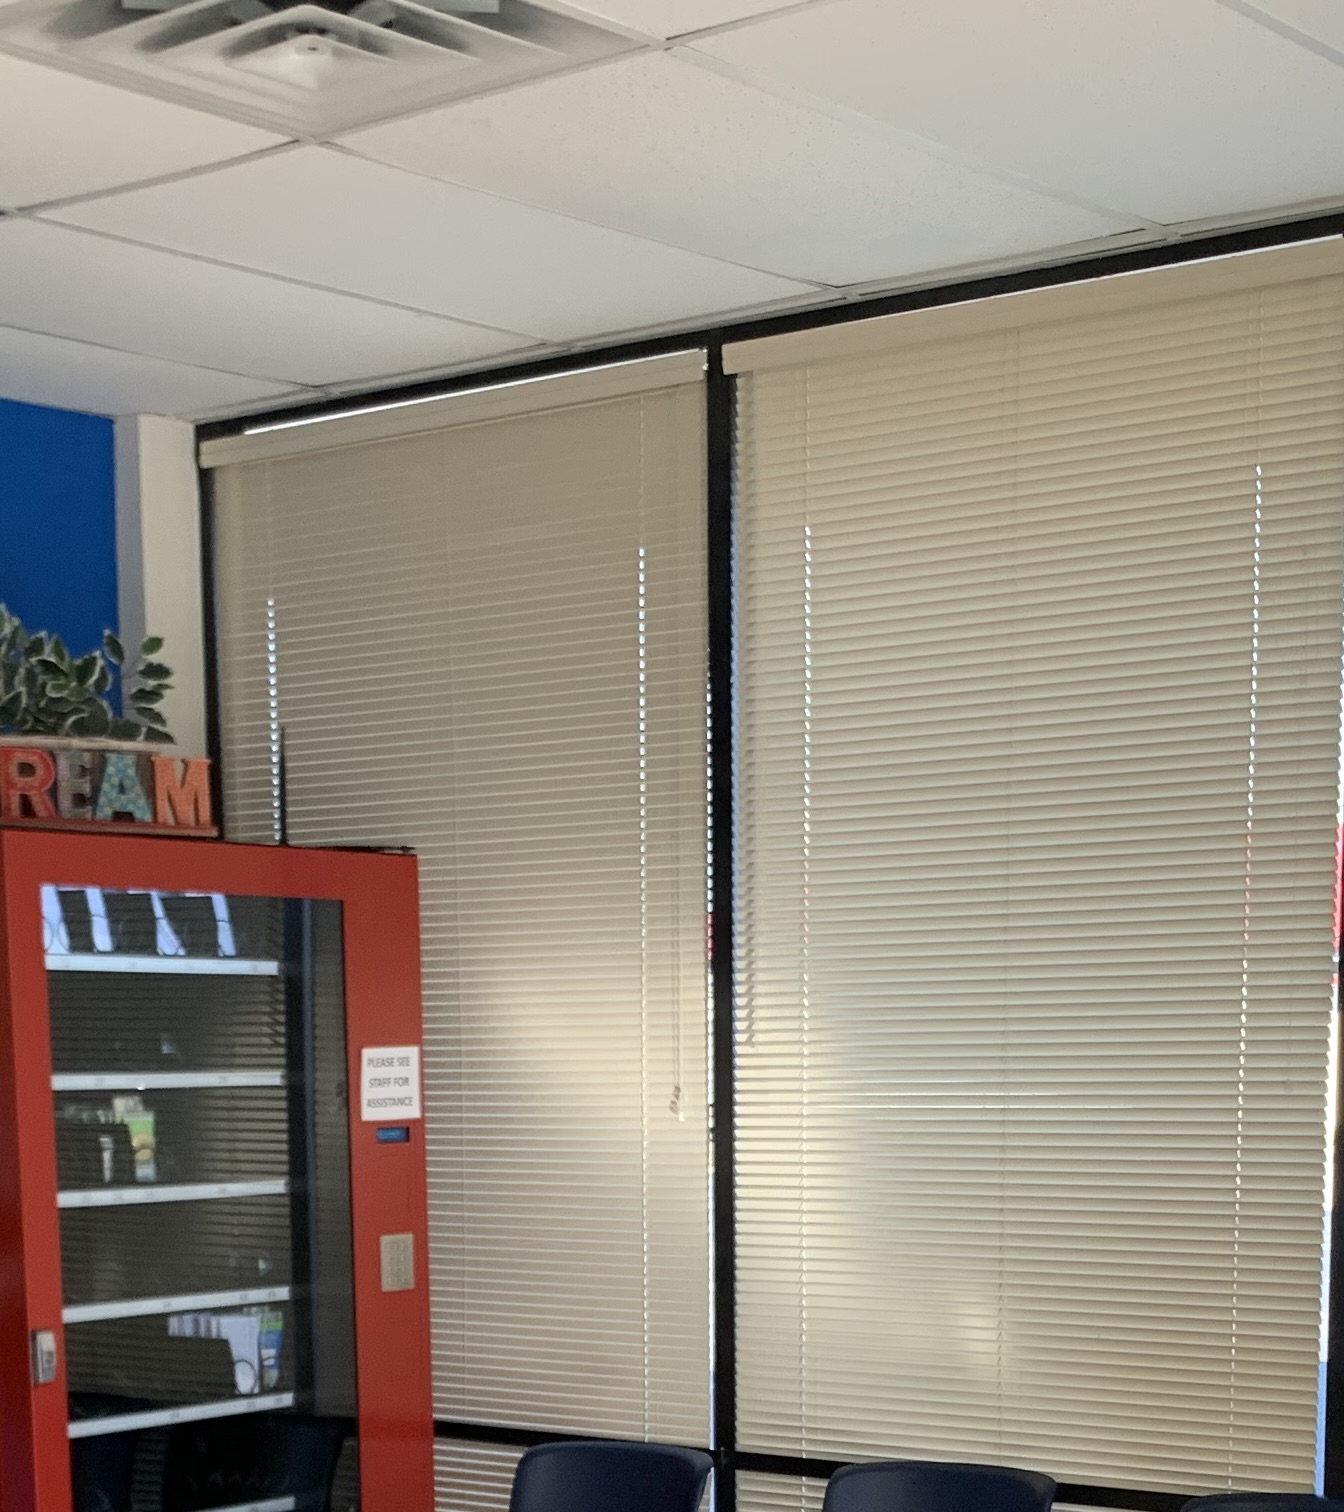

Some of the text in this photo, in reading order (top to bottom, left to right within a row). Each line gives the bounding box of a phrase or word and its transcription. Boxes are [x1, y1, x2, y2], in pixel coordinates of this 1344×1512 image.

[367, 1056, 411, 1068] PLEASE SEE
[368, 1077, 409, 1088] STAFF FOR
[366, 1096, 414, 1108] ASSISTANCE
